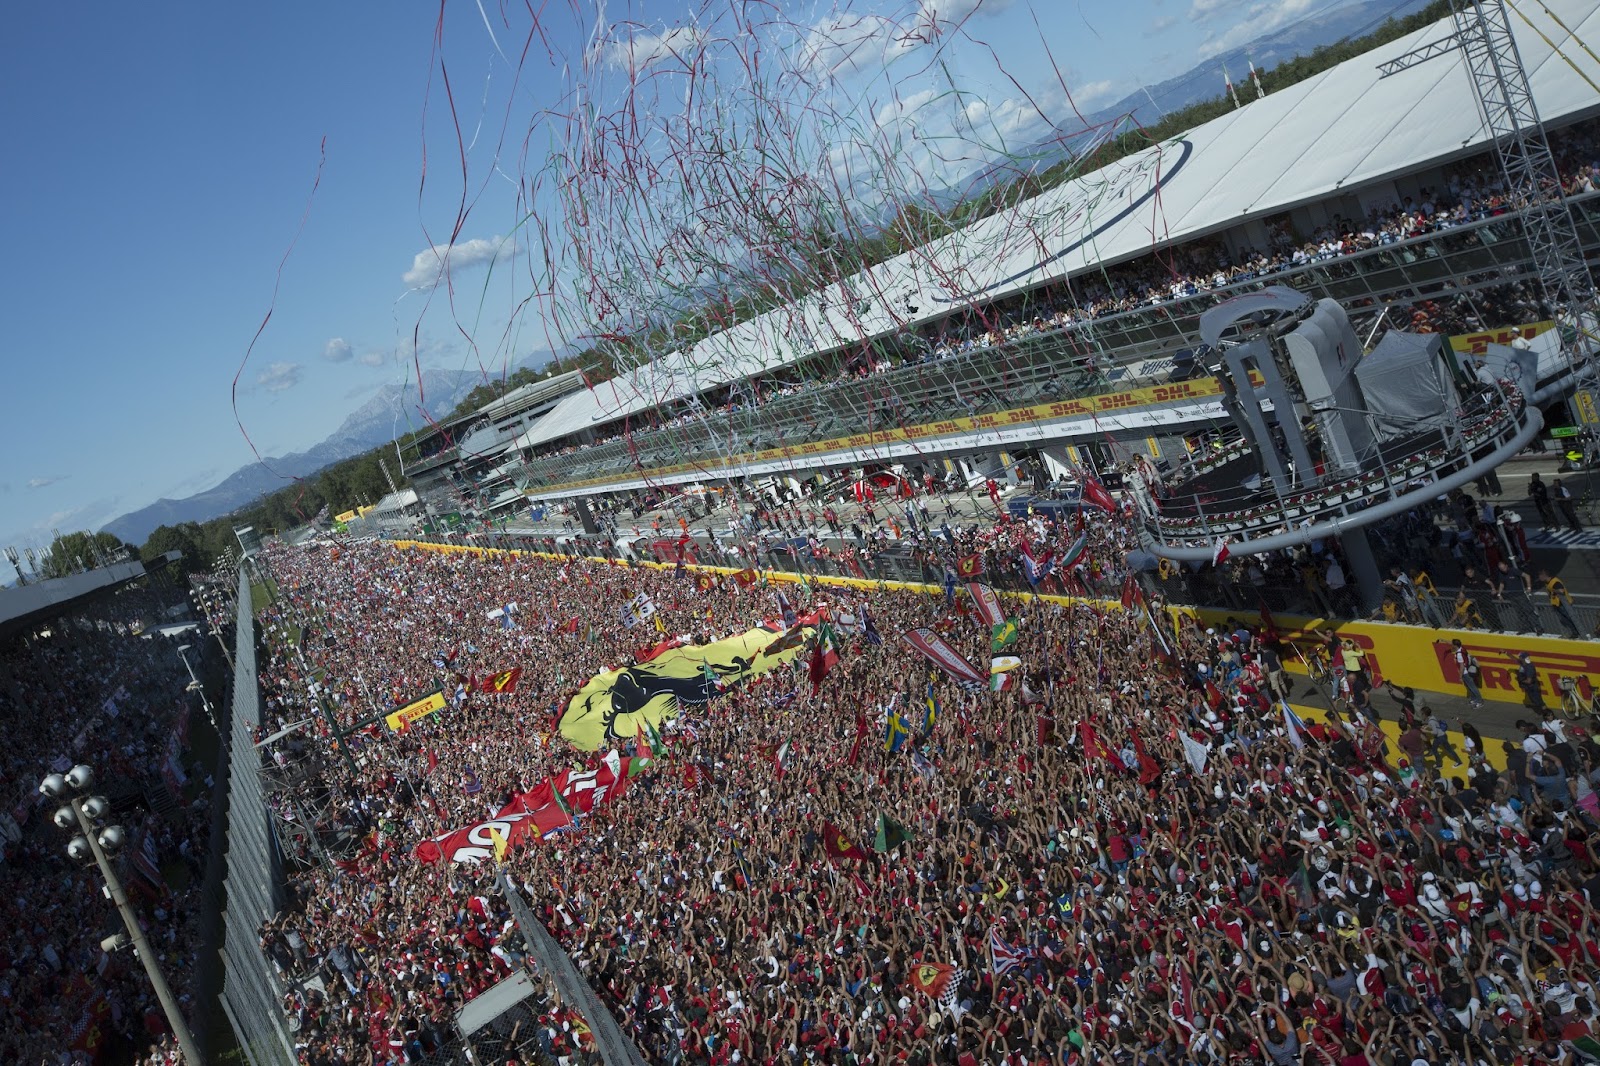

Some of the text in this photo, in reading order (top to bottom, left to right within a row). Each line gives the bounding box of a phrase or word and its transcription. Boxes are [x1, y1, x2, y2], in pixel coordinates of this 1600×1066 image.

[1152, 384, 1197, 402] DHL
[1098, 393, 1138, 409] DHL
[1050, 402, 1087, 416] DHL
[1008, 409, 1041, 422] DHL
[935, 423, 961, 433] DHL
[970, 416, 998, 428] DHL
[875, 432, 898, 442] DHL
[903, 427, 928, 438] DHL
